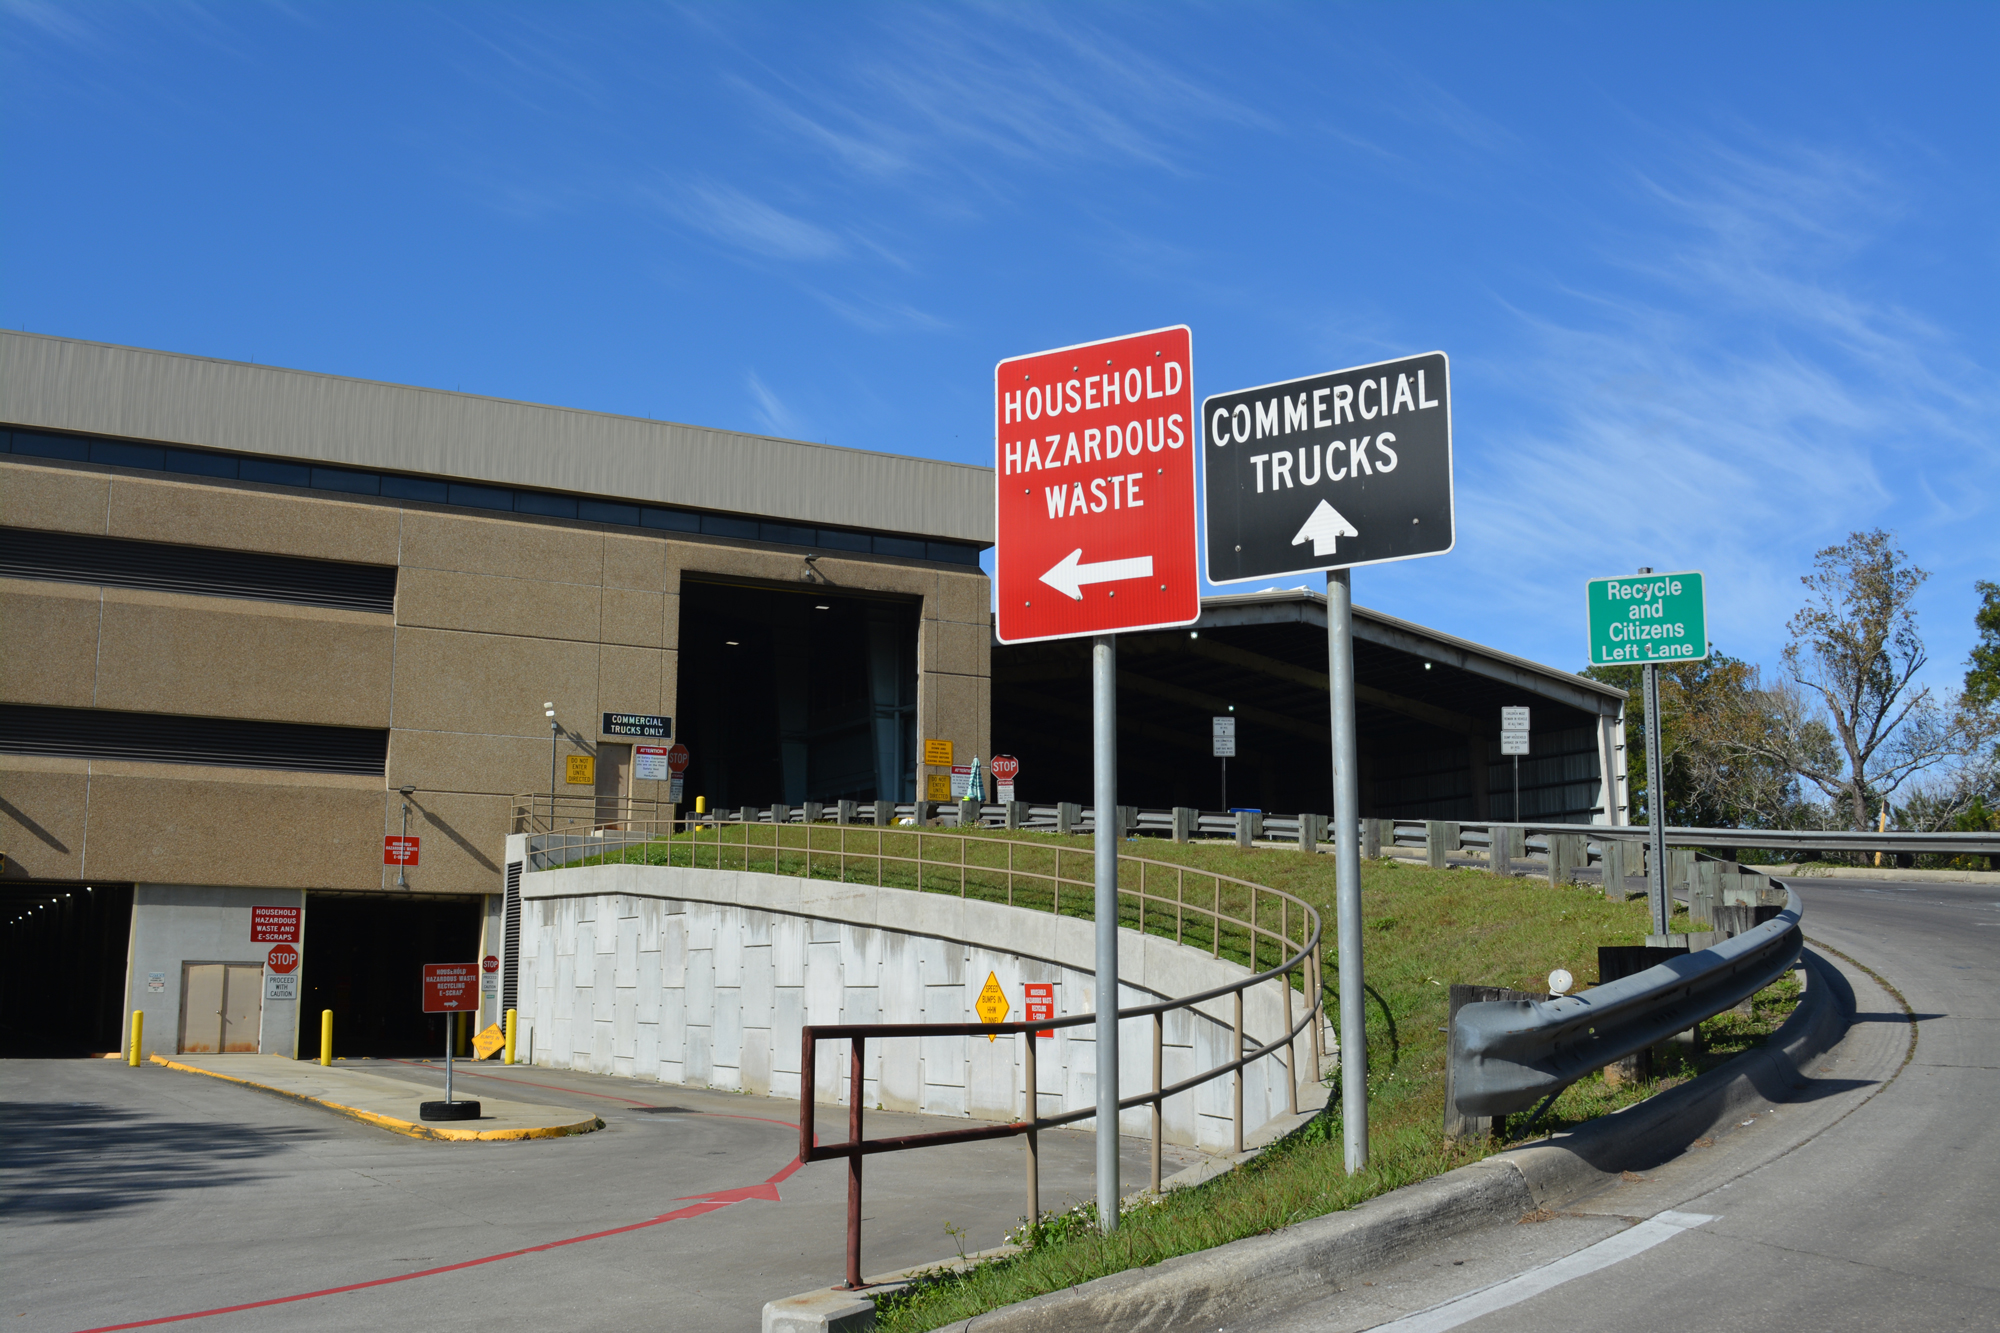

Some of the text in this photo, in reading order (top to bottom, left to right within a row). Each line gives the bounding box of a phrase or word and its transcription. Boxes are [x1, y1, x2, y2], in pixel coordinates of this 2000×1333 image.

[1004, 361, 1184, 425] HOUSEHOLD
[1211, 369, 1439, 447] COMMERCIAL
[1004, 413, 1185, 476] HAZARDOUS
[1250, 431, 1399, 494] TRUCKS
[1045, 472, 1145, 520] WASTE
[1607, 577, 1683, 602] Recycle
[1628, 598, 1663, 620] and
[1609, 621, 1685, 642] Citizens
[1602, 642, 1694, 661] Left Lane
[611, 725, 641, 734] TRUCKS
[612, 715, 663, 726] COMMERCIAL
[668, 752, 688, 764] STOP
[993, 761, 1016, 772] STOP
[270, 953, 297, 965] STOP
